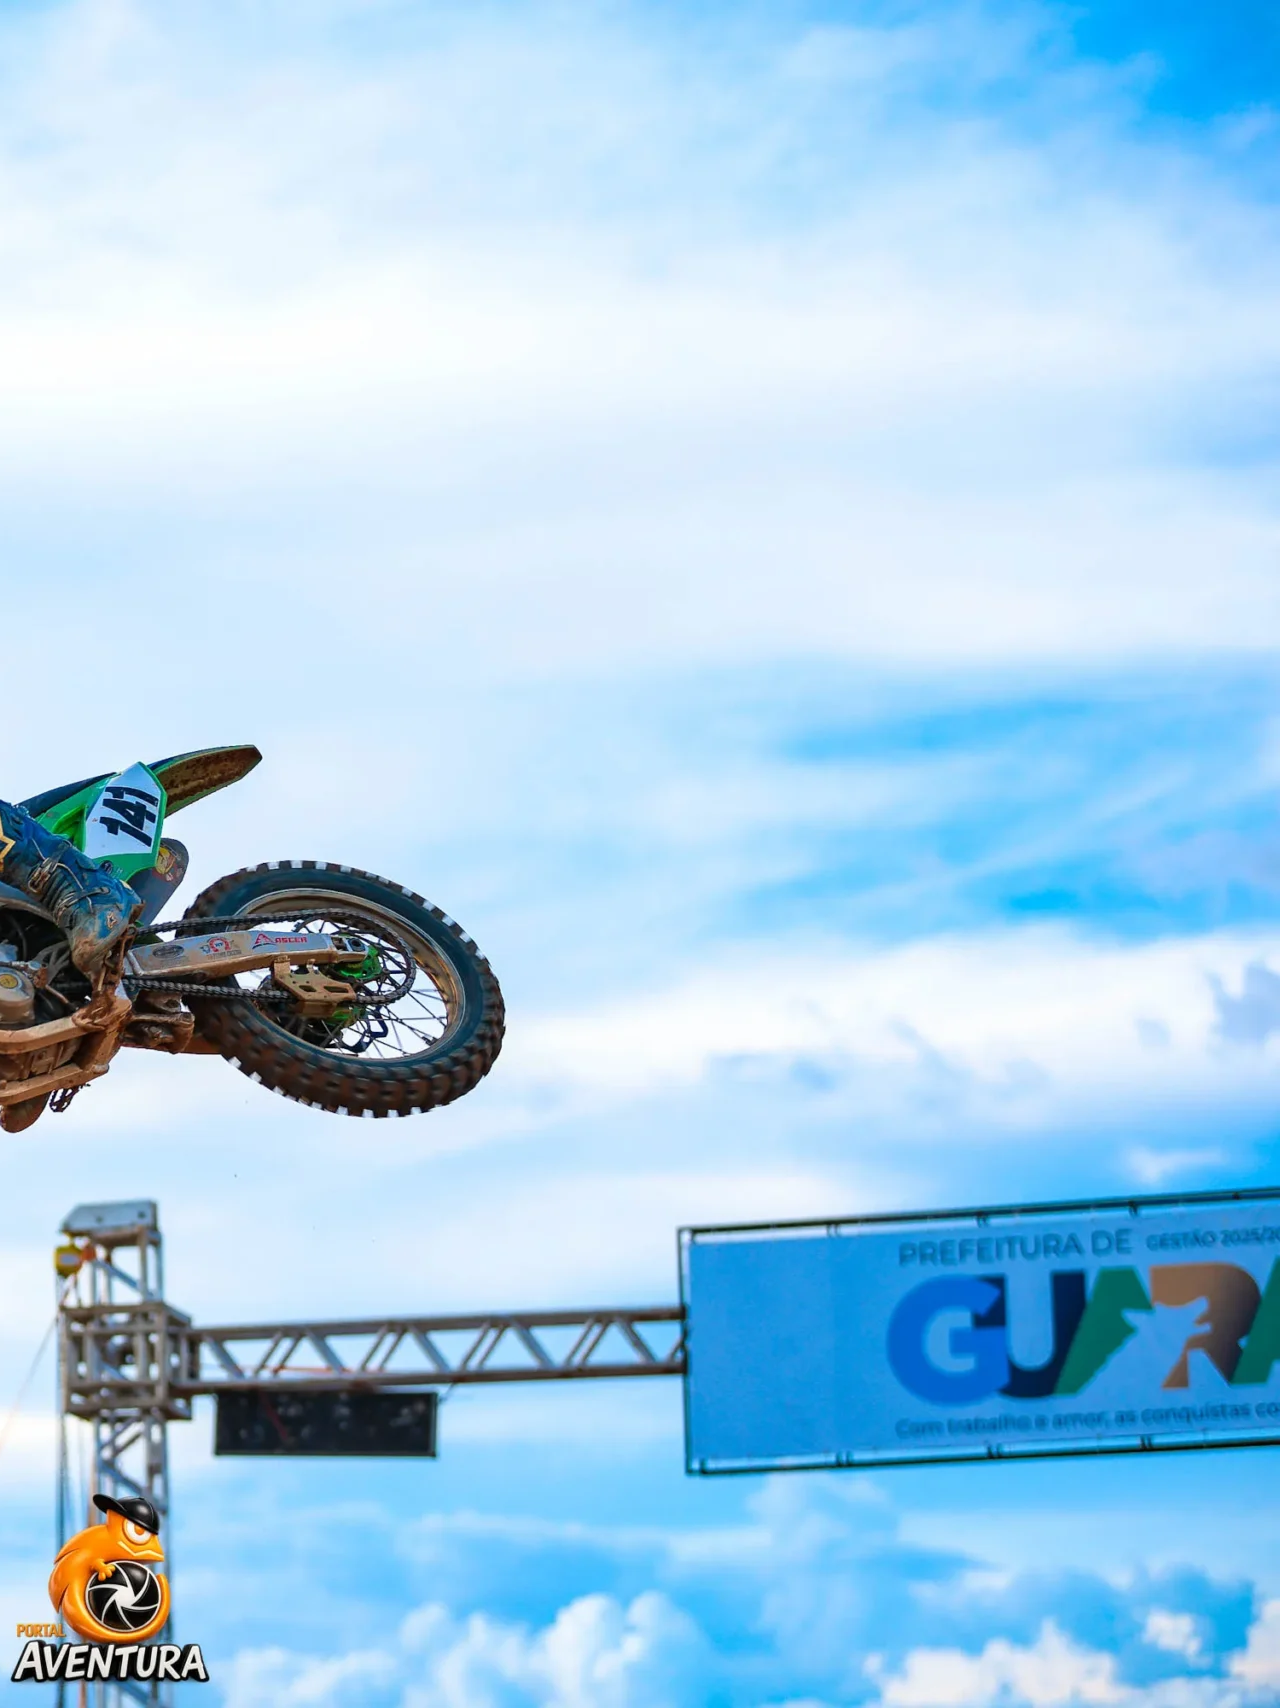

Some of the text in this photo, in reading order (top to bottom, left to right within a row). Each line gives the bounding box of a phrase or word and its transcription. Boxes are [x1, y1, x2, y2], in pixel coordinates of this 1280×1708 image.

[99, 786, 159, 847] 141
[898, 1232, 1085, 1267] PREFEITURA
[1091, 1229, 1133, 1257] DE
[895, 1417, 944, 1439] Com
[947, 1412, 1032, 1435] trabalho
[1034, 1415, 1047, 1431] e
[1141, 1403, 1250, 1427] conquistas
